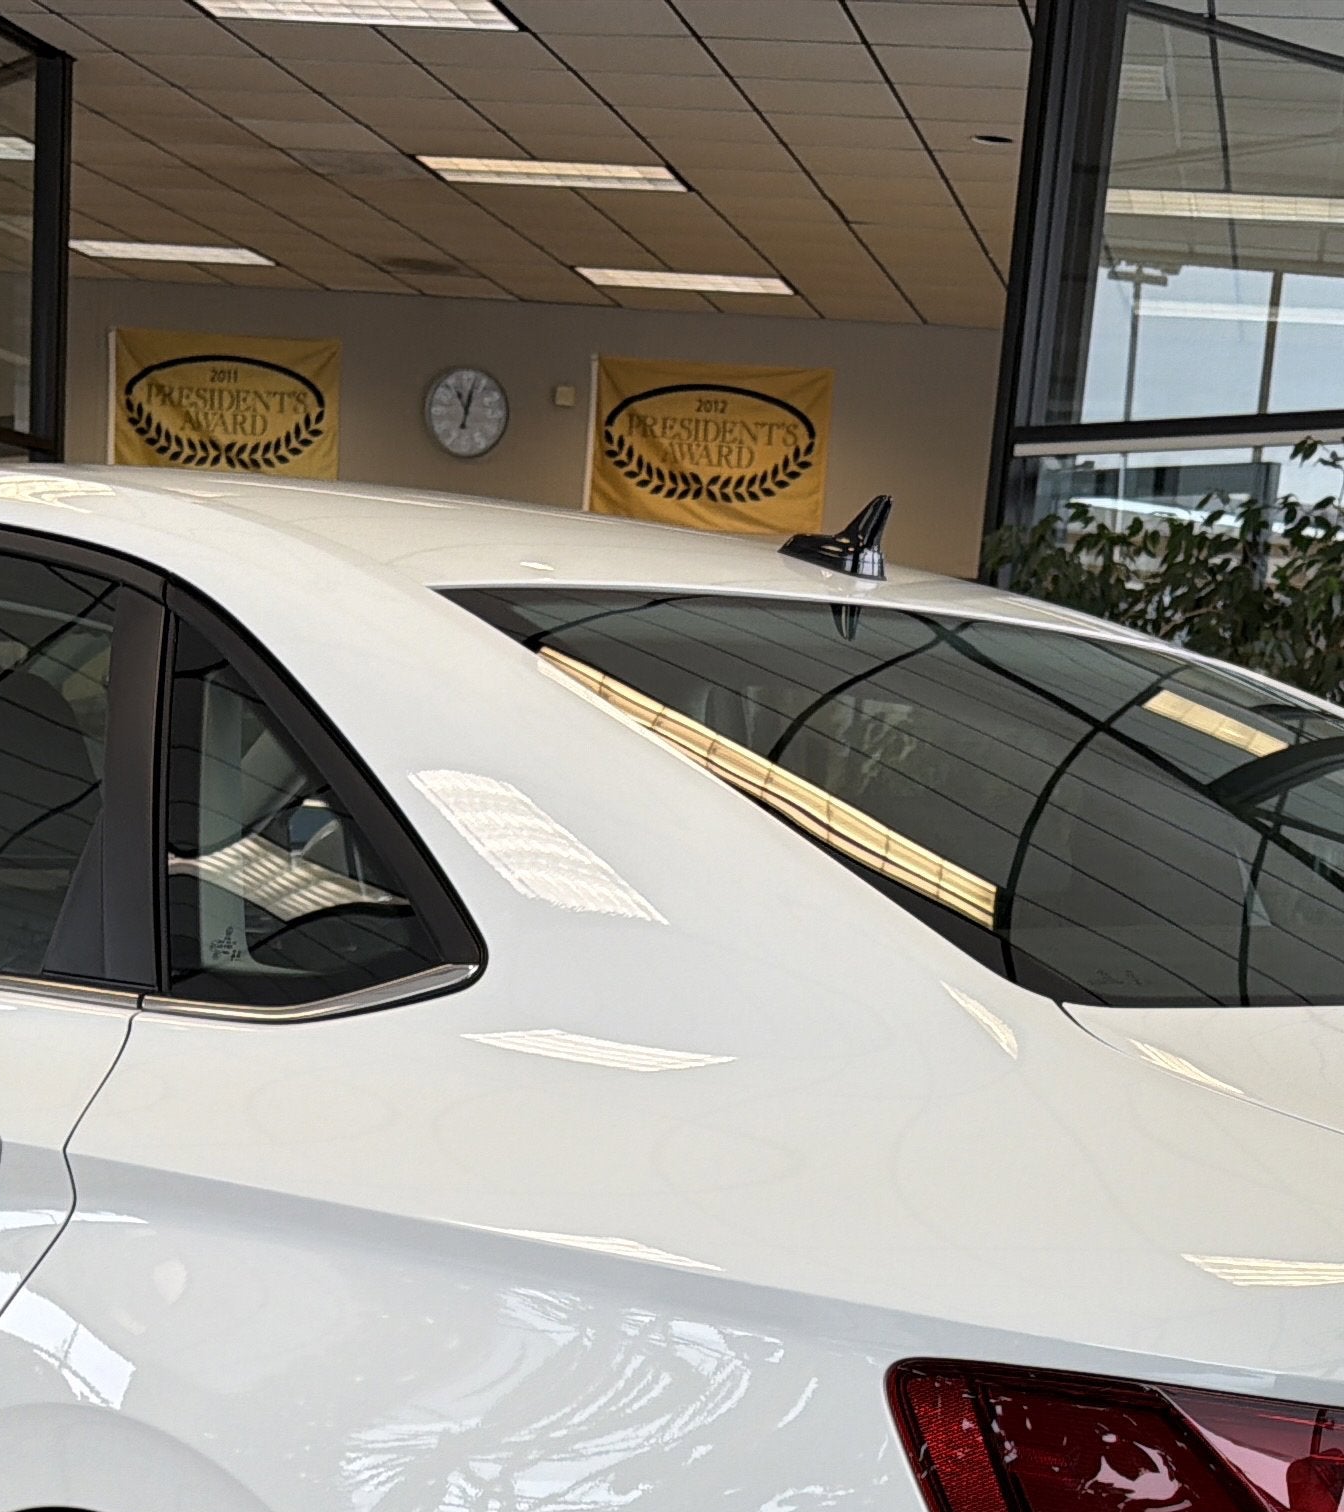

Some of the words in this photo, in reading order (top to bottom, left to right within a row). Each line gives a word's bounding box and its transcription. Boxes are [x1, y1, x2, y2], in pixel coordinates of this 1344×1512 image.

[209, 367, 240, 384] 2011
[145, 383, 308, 414] PRESIDENT'S
[695, 398, 728, 414] 2012
[179, 410, 269, 437] AWARD
[627, 412, 800, 447] PRESIDENT'S
[661, 441, 756, 470] AWARD
